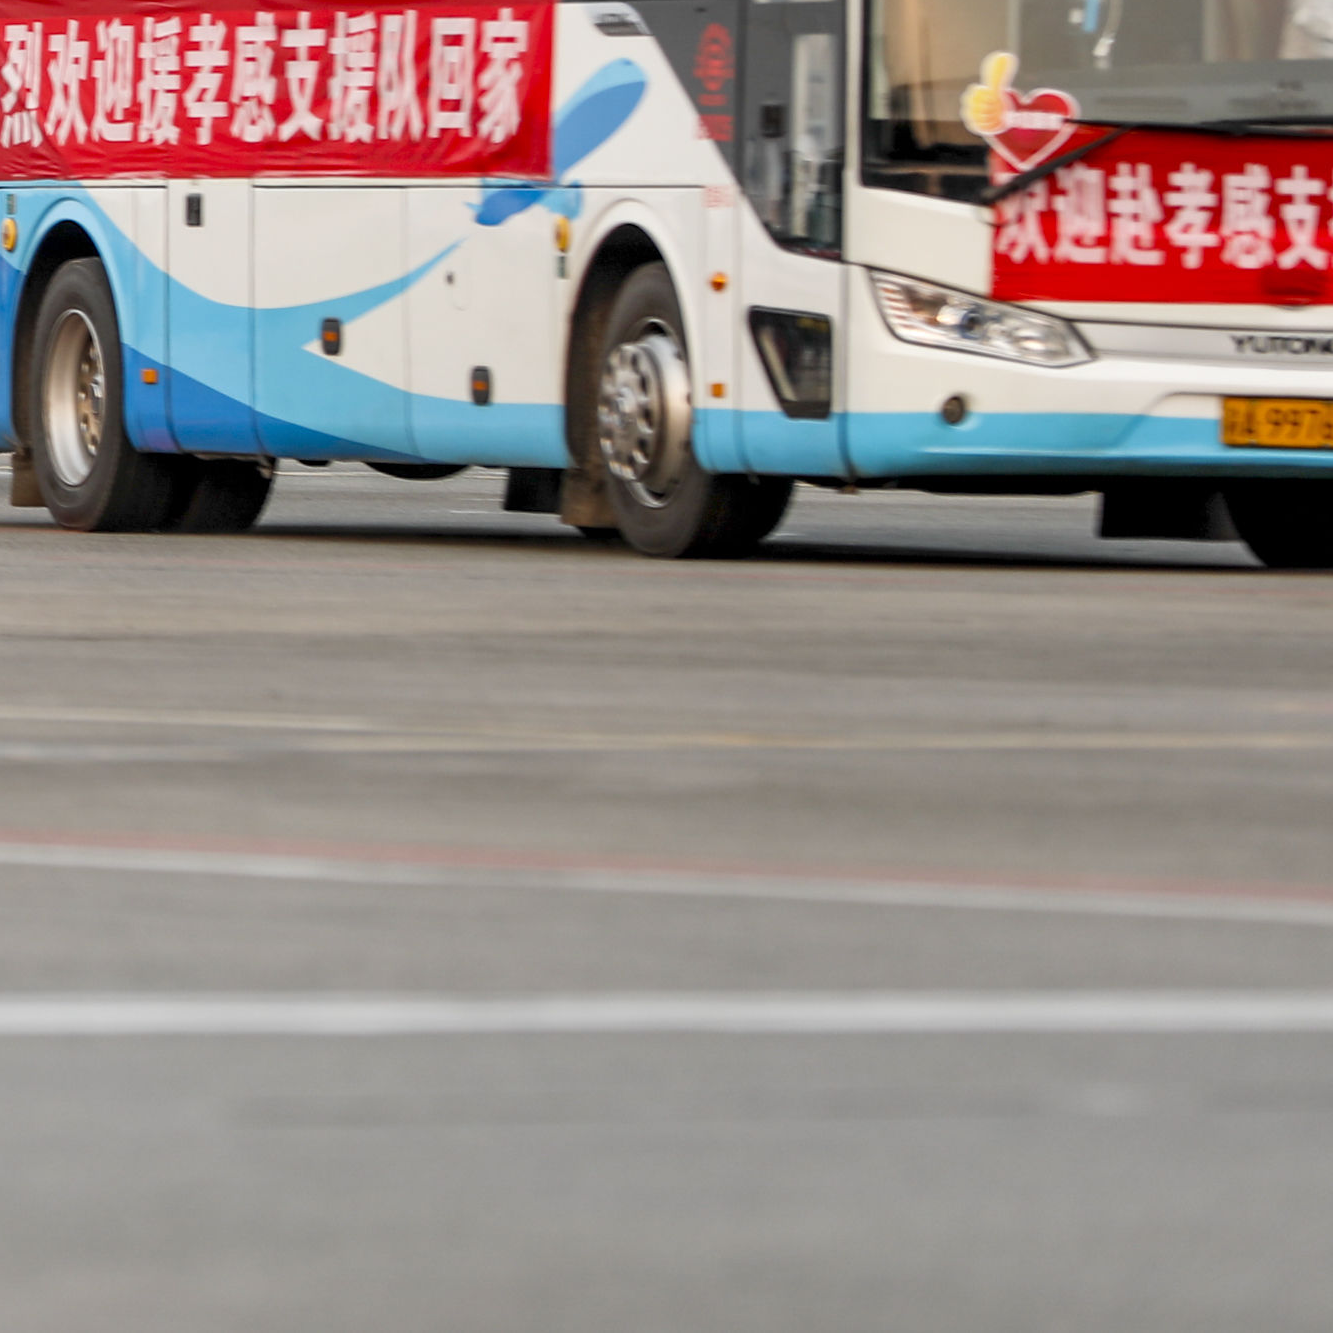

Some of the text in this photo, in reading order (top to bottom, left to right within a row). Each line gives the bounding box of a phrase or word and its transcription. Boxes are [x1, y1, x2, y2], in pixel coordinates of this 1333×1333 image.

[997, 162, 1333, 269] 欢迎赴孝感支
[1229, 335, 1333, 355] YUTON
